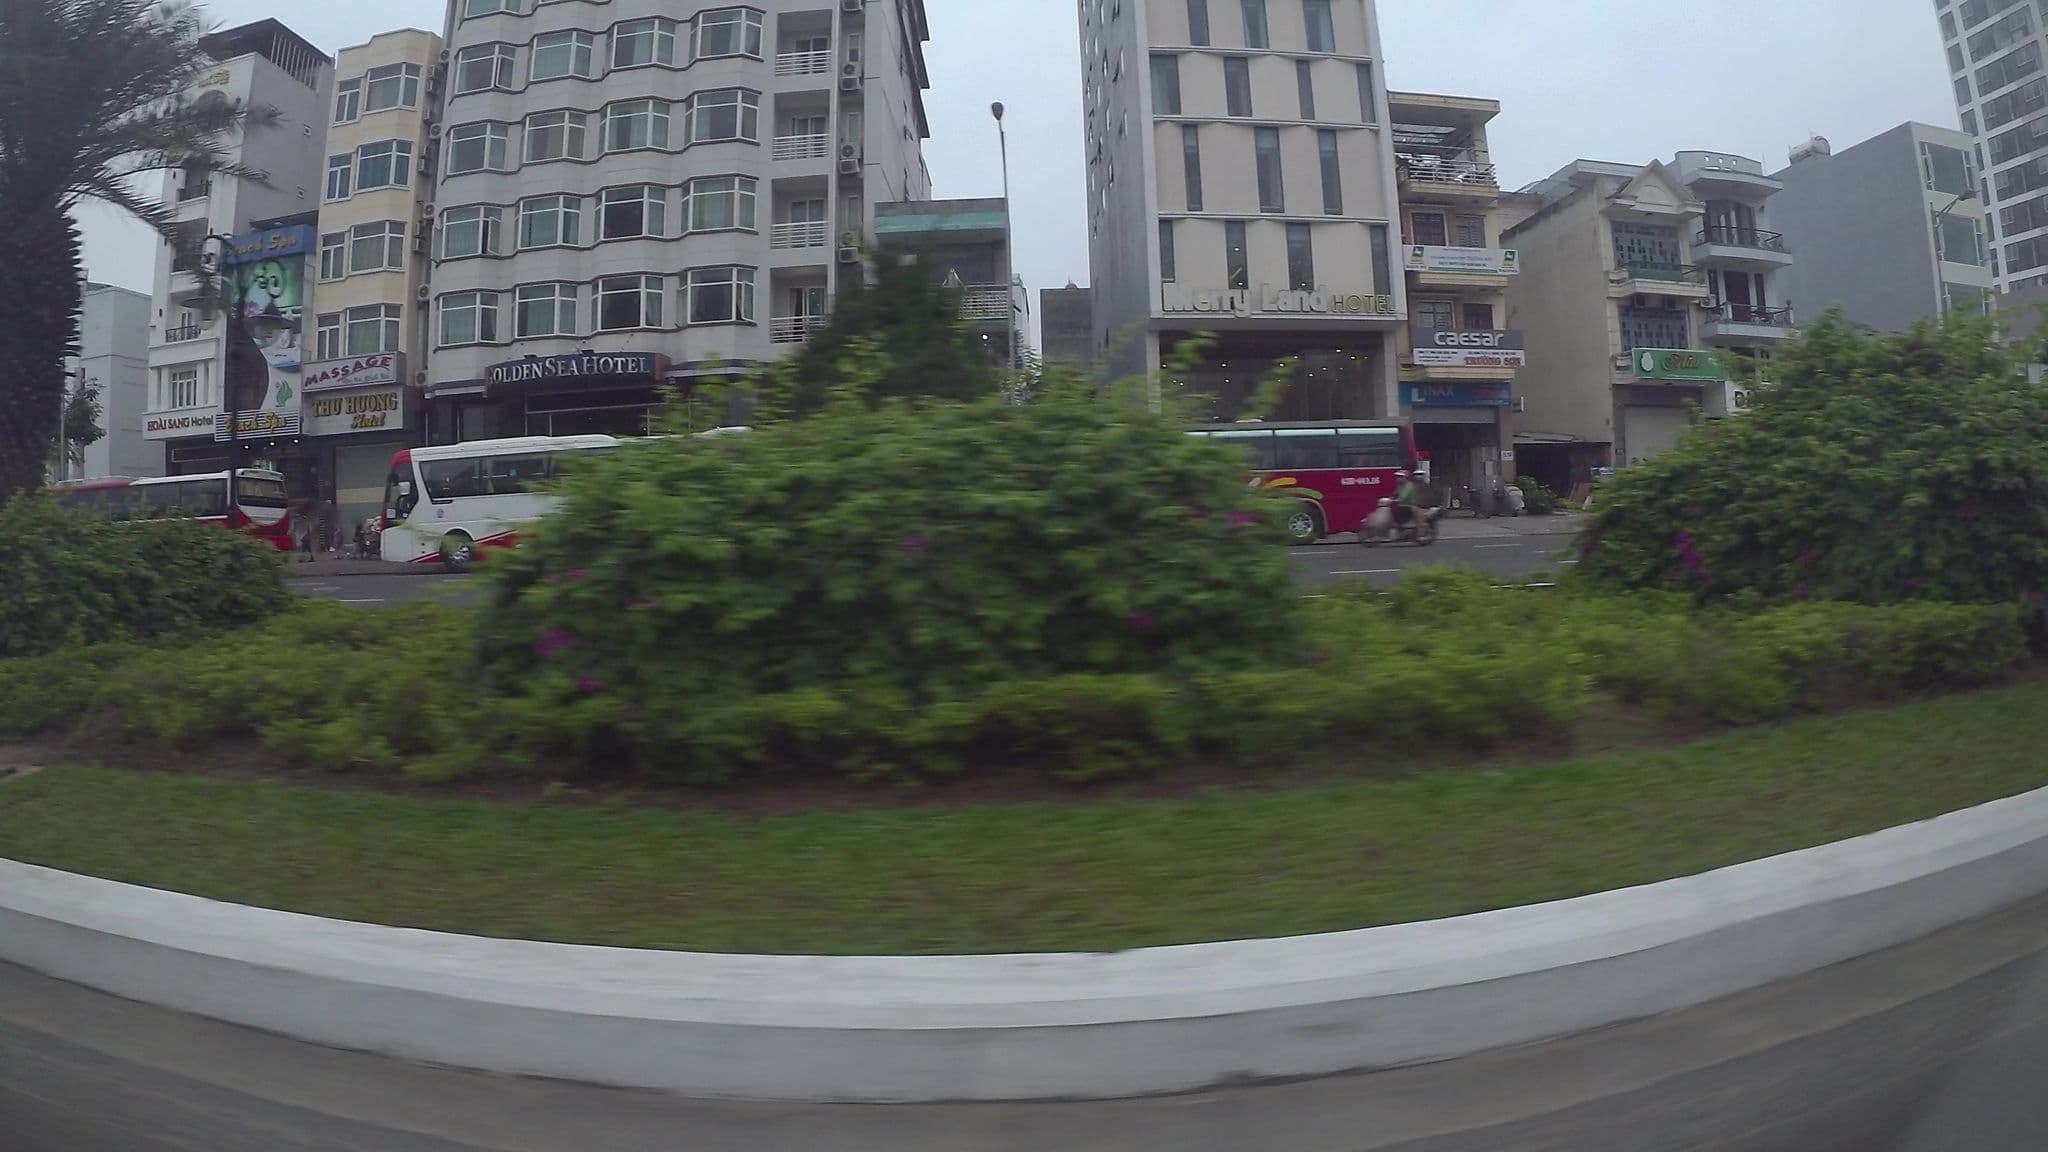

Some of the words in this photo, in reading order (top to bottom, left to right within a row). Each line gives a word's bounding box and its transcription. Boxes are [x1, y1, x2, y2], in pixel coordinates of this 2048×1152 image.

[1261, 282, 1328, 313] Land
[1333, 294, 1396, 314] HOTEL
[1433, 331, 1504, 346] caesar
[304, 356, 393, 387] MASSAGE
[312, 398, 343, 417] THU
[168, 416, 190, 429] SANG
[191, 415, 214, 427] Hotel
[263, 411, 288, 432] Spa
